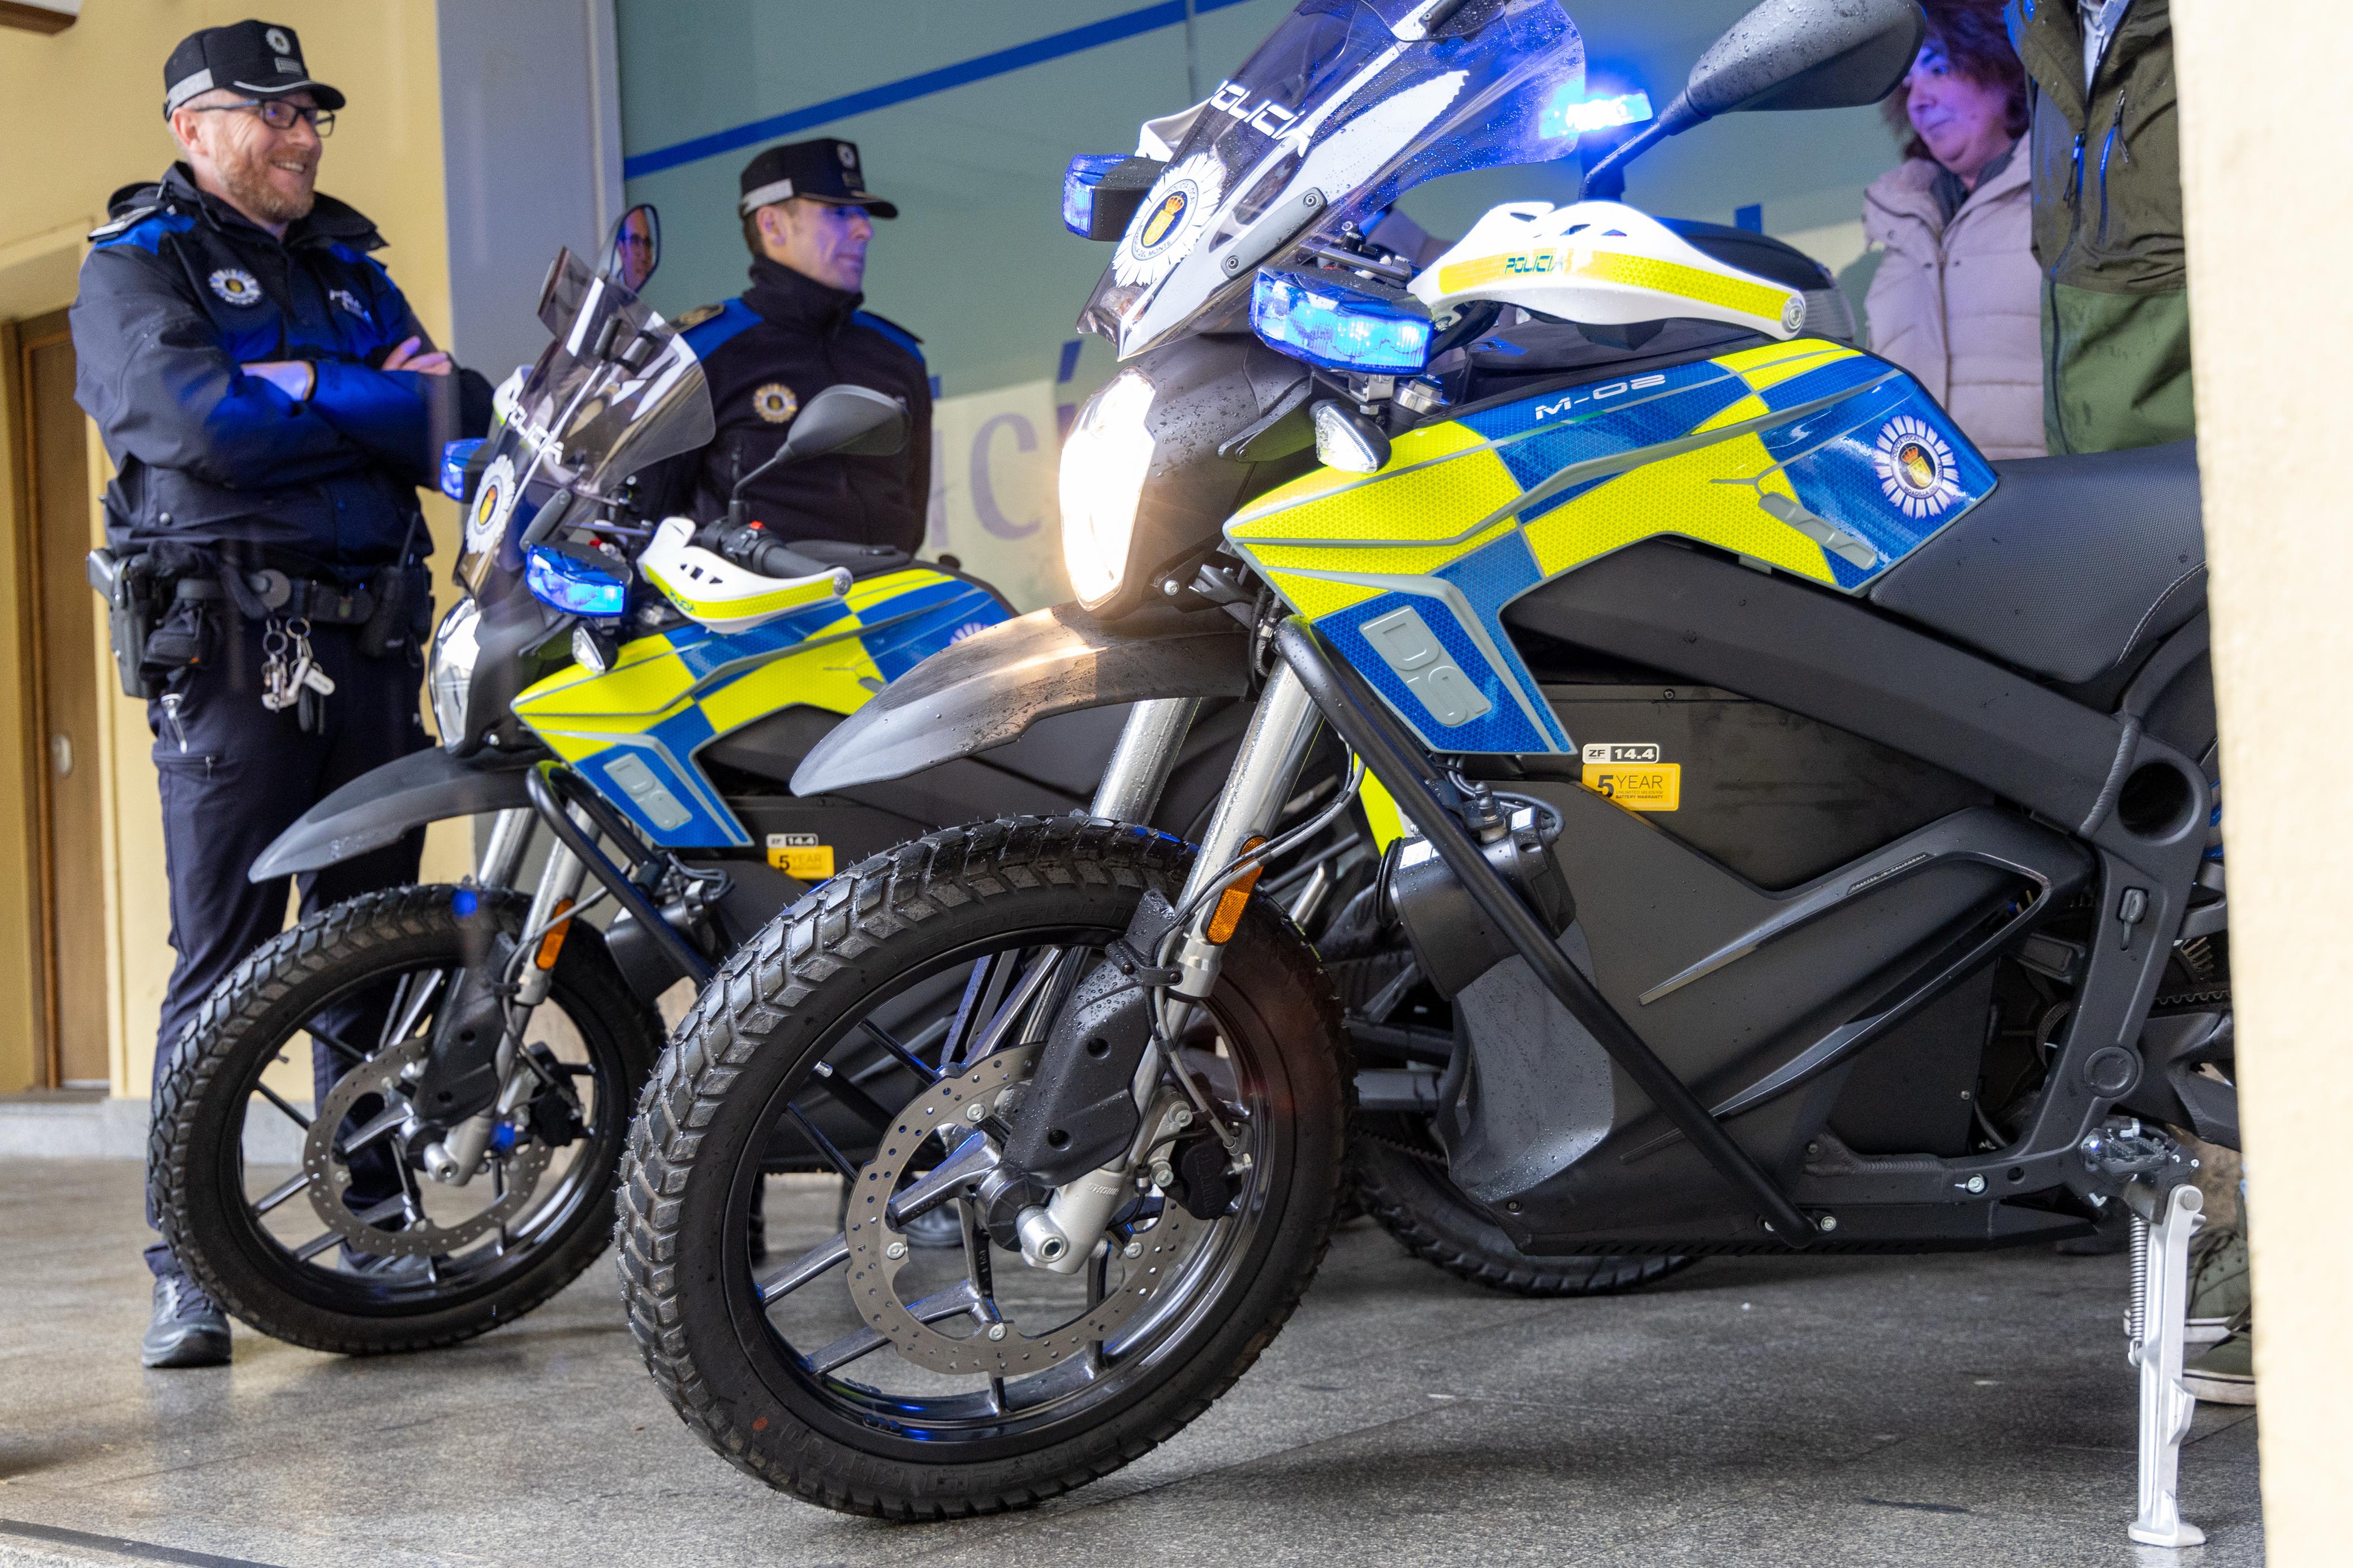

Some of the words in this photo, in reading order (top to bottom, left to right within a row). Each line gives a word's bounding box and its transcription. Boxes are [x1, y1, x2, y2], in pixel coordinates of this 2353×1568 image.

[1148, 240, 1172, 257] MONTE
[1535, 374, 1666, 421] M-02
[1904, 486, 1929, 496] BOADILLA
[1615, 748, 1654, 759] 14.4
[1597, 775, 1614, 798] 5
[1616, 775, 1663, 789] YEAR
[779, 855, 790, 871] 5
[793, 854, 822, 863] YEAR
[1891, 854, 1926, 872] CALIFORNIA
